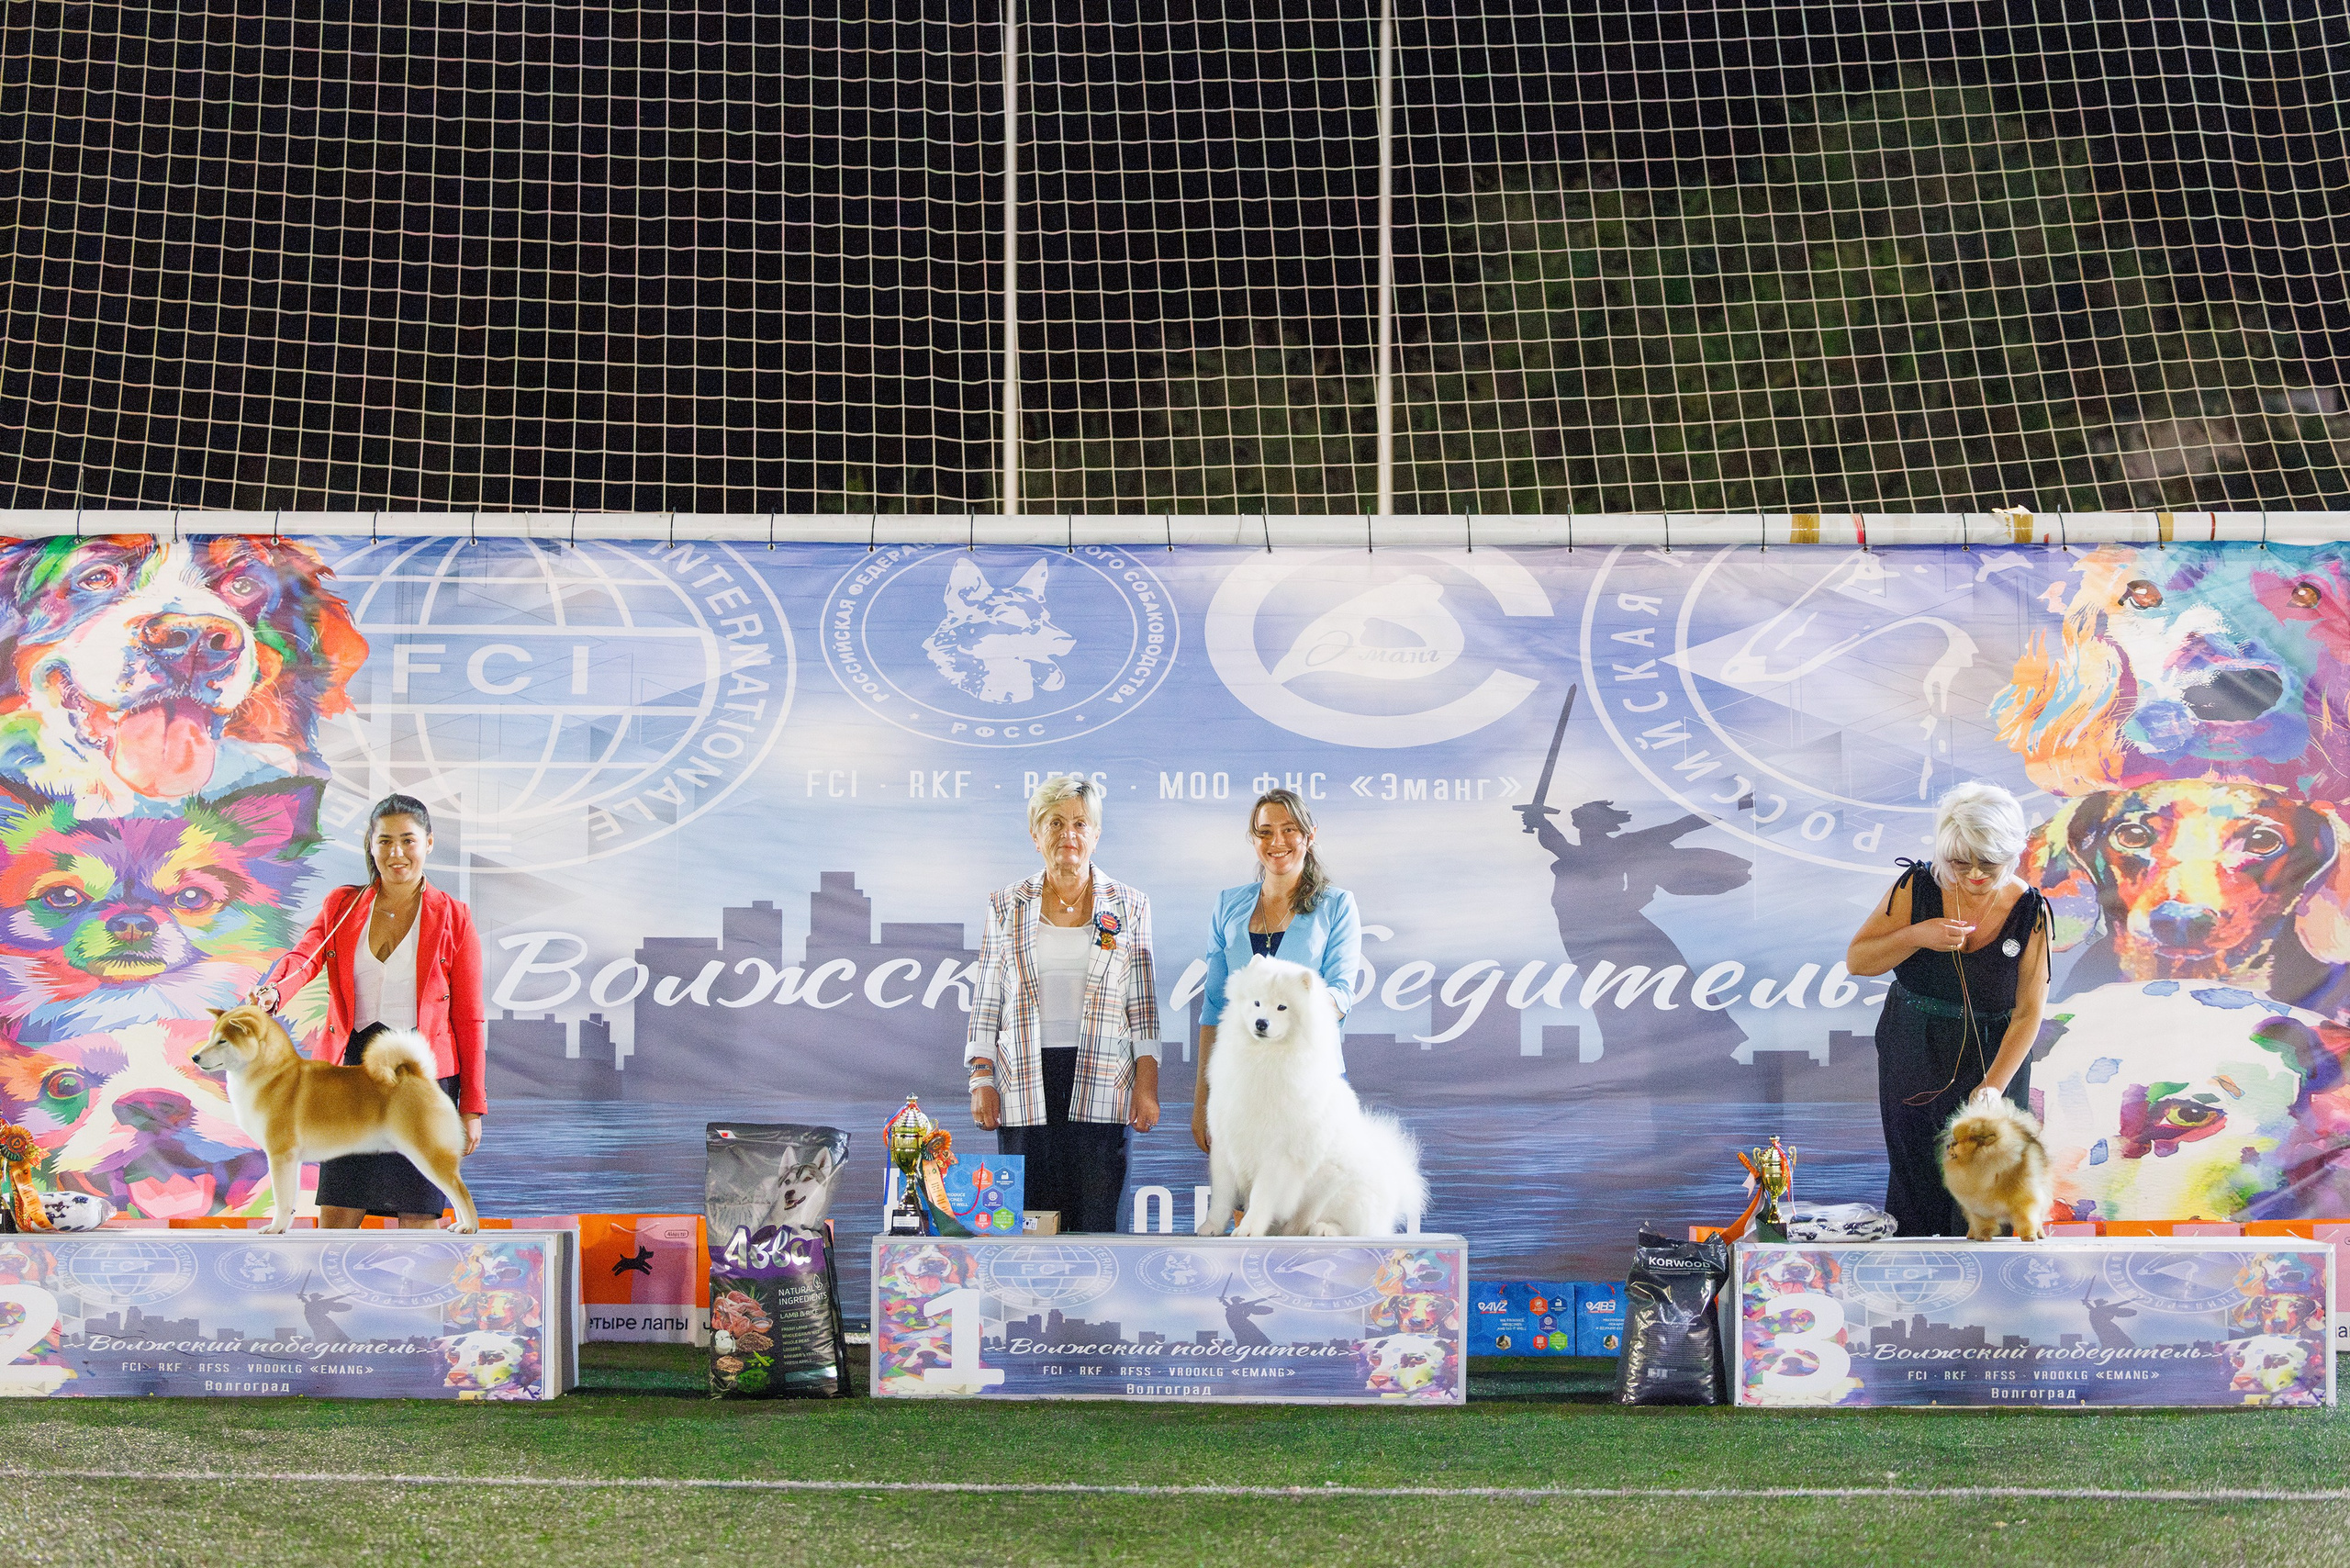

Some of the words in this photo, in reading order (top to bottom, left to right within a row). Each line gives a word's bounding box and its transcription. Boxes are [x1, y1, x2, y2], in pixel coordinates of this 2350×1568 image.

[1106, 571, 1164, 703] СОБАКОВОДСТВА
[833, 599, 890, 702] РОССИЙСКАЯ
[392, 644, 590, 695] FCI
[951, 722, 1046, 738] РФСС
[1610, 592, 1885, 853] РОССИЙСКАЯ
[806, 769, 857, 798] FCI
[909, 769, 971, 799] RKF
[1159, 771, 1230, 800] МОО
[1252, 771, 1326, 800] ФКС
[1349, 773, 1522, 801] «Эманг»
[491, 931, 979, 1012] Волжск
[100, 1260, 150, 1272] FCI
[1021, 1263, 1070, 1275] FCI
[1649, 1256, 1710, 1268] KORWOOD
[1885, 1268, 1933, 1280] FCI
[778, 1285, 815, 1296] NATURAL
[778, 1292, 827, 1305] INGREDIENTS
[589, 1317, 637, 1329] тыре
[642, 1317, 688, 1330] лапы
[0, 1284, 62, 1383] 2
[923, 1288, 1004, 1384] 1
[250, 1335, 439, 1360] победитель»
[1170, 1338, 1360, 1363] победитель»
[1762, 1293, 1851, 1394] 3
[2035, 1342, 2222, 1366] победитель»
[122, 1362, 142, 1372] FCI
[158, 1362, 182, 1372] RKF
[199, 1363, 229, 1373] RFSS
[310, 1364, 374, 1375] «EMANG»
[1043, 1365, 1062, 1375] FCI
[1080, 1366, 1102, 1375] RKF
[1120, 1366, 1151, 1376] RFSS
[1231, 1368, 1295, 1377] «EMANG»
[1908, 1371, 1927, 1381] FCI
[1944, 1371, 1967, 1381] RKF
[1985, 1371, 2016, 1381] RFSS
[2096, 1371, 2160, 1381] «EMANG»
[206, 1380, 290, 1394] Волгоград
[1127, 1383, 1212, 1395] Волгоград
[1991, 1387, 2076, 1399] Волгоград
